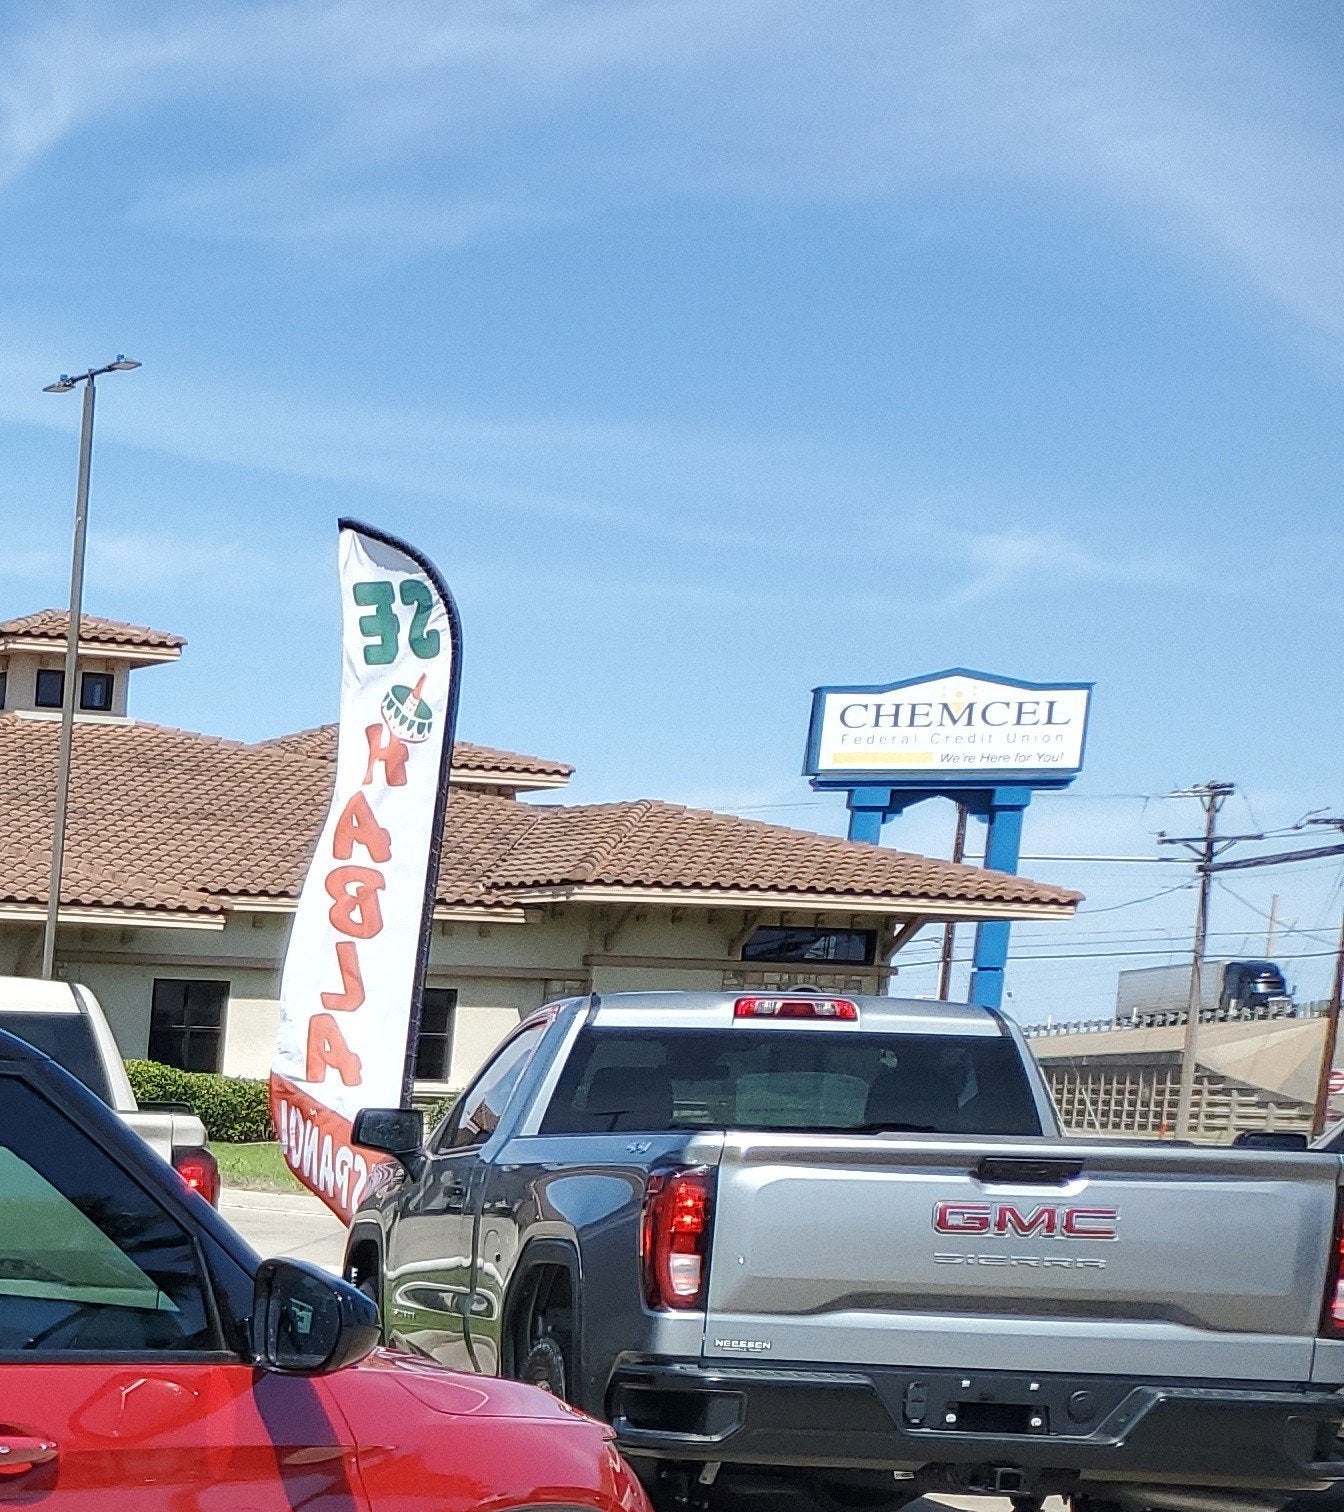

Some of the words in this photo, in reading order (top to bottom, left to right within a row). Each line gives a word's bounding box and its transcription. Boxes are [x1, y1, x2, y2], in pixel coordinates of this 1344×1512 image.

[839, 700, 1072, 729] CHEMCEL
[841, 733, 917, 745] Federal
[930, 732, 993, 745] Credit
[1006, 732, 1064, 744] Union
[940, 752, 976, 763] We're
[980, 752, 1011, 763] Here
[1014, 752, 1033, 763] for
[1036, 752, 1065, 763] You!
[931, 1200, 1121, 1242] GMC
[934, 1252, 1108, 1269] SIERRA
